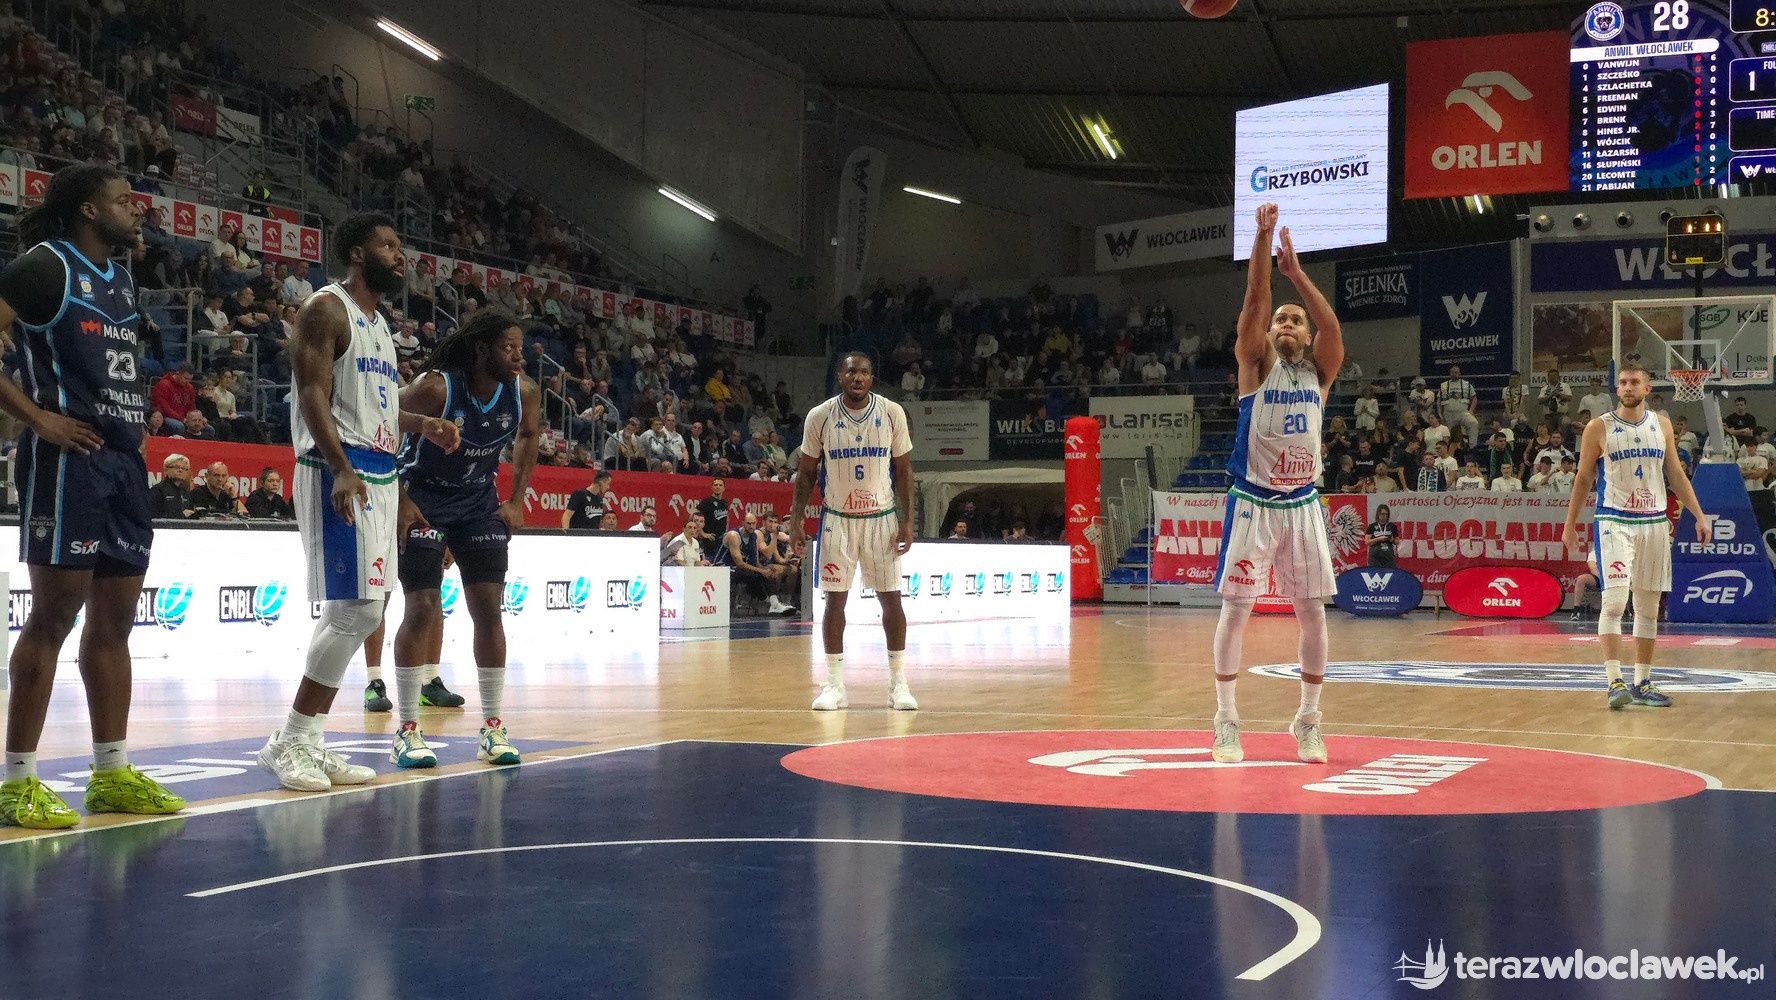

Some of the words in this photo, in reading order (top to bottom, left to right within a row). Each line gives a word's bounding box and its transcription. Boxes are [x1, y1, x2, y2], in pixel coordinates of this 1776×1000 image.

[1653, 0, 1689, 31] 28
[1604, 45, 1633, 58] ANWIL
[1636, 41, 1694, 55] WŁOCŁAWEK
[1597, 60, 1640, 69] VANWIJN
[1597, 70, 1640, 80] SZCZEŚKO
[1748, 70, 1756, 91] 1
[1597, 80, 1652, 91] SZLACHETKA
[1710, 76, 1716, 84] 0
[1597, 92, 1638, 102] FREEMAN
[1597, 105, 1627, 114] EDWIN
[1597, 116, 1626, 124] BRENK
[1710, 110, 1716, 118] 3
[1596, 128, 1623, 136] HINES
[1626, 126, 1640, 134] JR.
[1596, 138, 1631, 146] WÓJCIK
[1431, 140, 1542, 171] ORLEN
[1596, 148, 1638, 158] ŁAZARSKI
[1582, 162, 1592, 170] 16
[1596, 158, 1641, 168] SŁUPIŃSKI
[1250, 161, 1370, 193] GRZYBOWSKI
[1596, 171, 1636, 180] LECOMTE
[1582, 184, 1592, 192] 21
[1596, 182, 1634, 190] PABIJAN
[1146, 223, 1227, 248] WŁOCŁAWEK
[1614, 242, 1776, 282] WŁCŁ
[1345, 273, 1409, 300] SELENKA
[1430, 334, 1499, 351] WŁOCŁAWEK
[105, 349, 137, 382] 23
[378, 386, 387, 409] 5
[1284, 413, 1307, 435] 20
[828, 446, 888, 460] WŁOCŁAWEK
[854, 464, 865, 480] 6
[1634, 464, 1643, 480] 4
[1184, 497, 1220, 510] naszej
[1388, 495, 1440, 507] wartości
[1443, 495, 1498, 510] Ojczyzna
[1501, 494, 1522, 509] jest
[1526, 497, 1542, 507] na
[1677, 542, 1756, 556] TERBUD
[1228, 575, 1256, 586] ORLEN
[1352, 594, 1400, 603] WŁOCŁAWEK
[1482, 598, 1521, 607] ORLEN
[1683, 586, 1739, 604] PGE
[220, 589, 254, 620] ENBL
[699, 605, 717, 615] ORLEN
[1302, 754, 1490, 795] ORLEN
